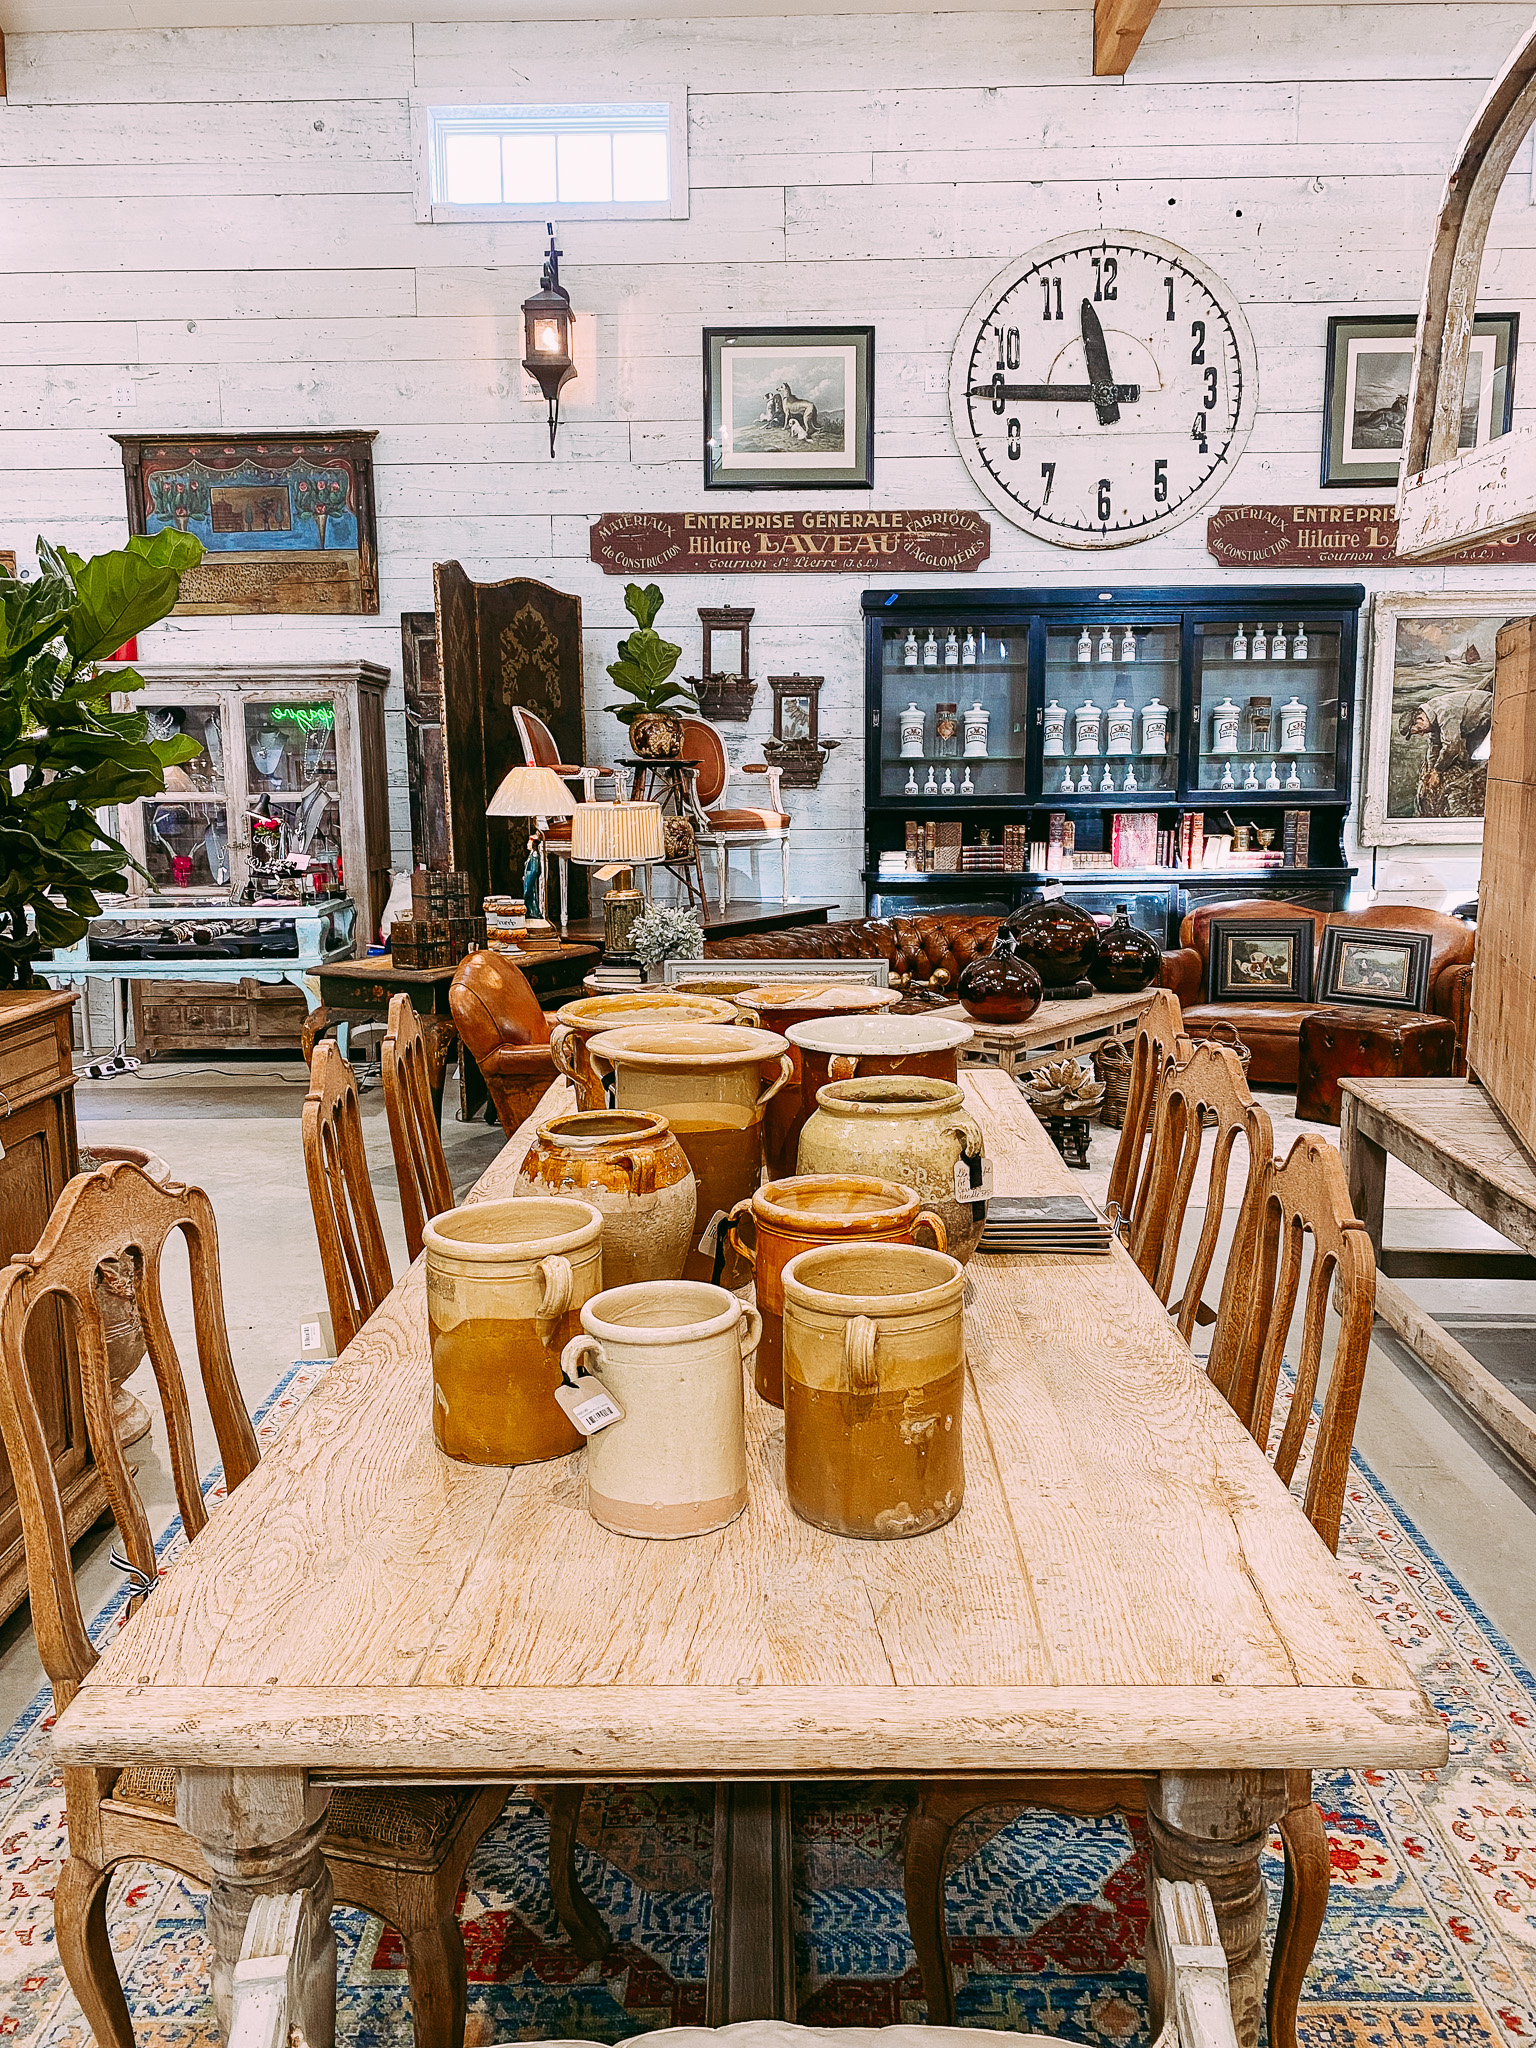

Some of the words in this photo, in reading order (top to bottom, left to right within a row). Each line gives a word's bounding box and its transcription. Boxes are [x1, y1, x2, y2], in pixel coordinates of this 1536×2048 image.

[1040, 276, 1064, 321] 11
[1091, 257, 1118, 302] 12
[1163, 276, 1175, 321] 1
[994, 326, 1020, 370] 10
[1191, 320, 1206, 365] 2
[1203, 367, 1217, 410] 3
[1006, 417, 1021, 460] 8
[1190, 412, 1208, 454] 4
[1041, 462, 1056, 505] 7
[1097, 479, 1111, 521] 6
[1154, 459, 1168, 501] 5
[684, 513, 795, 529] ENTREPRISE
[802, 511, 903, 528] GÉNÉRALE
[905, 512, 980, 534] FABRIQUE
[1292, 506, 1395, 522] ENTREPRIS
[601, 545, 615, 559] de
[615, 543, 682, 569] CONSTRUCTION
[687, 536, 751, 555] Hilaire
[754, 532, 900, 556] LAVEAU
[1212, 537, 1224, 550] de
[1223, 535, 1291, 561] CONSTRUCTION
[1297, 529, 1360, 548] Hilaire
[1319, 552, 1374, 561] Tournon
[708, 557, 767, 568] Tournon
[793, 556, 838, 568] Pierre
